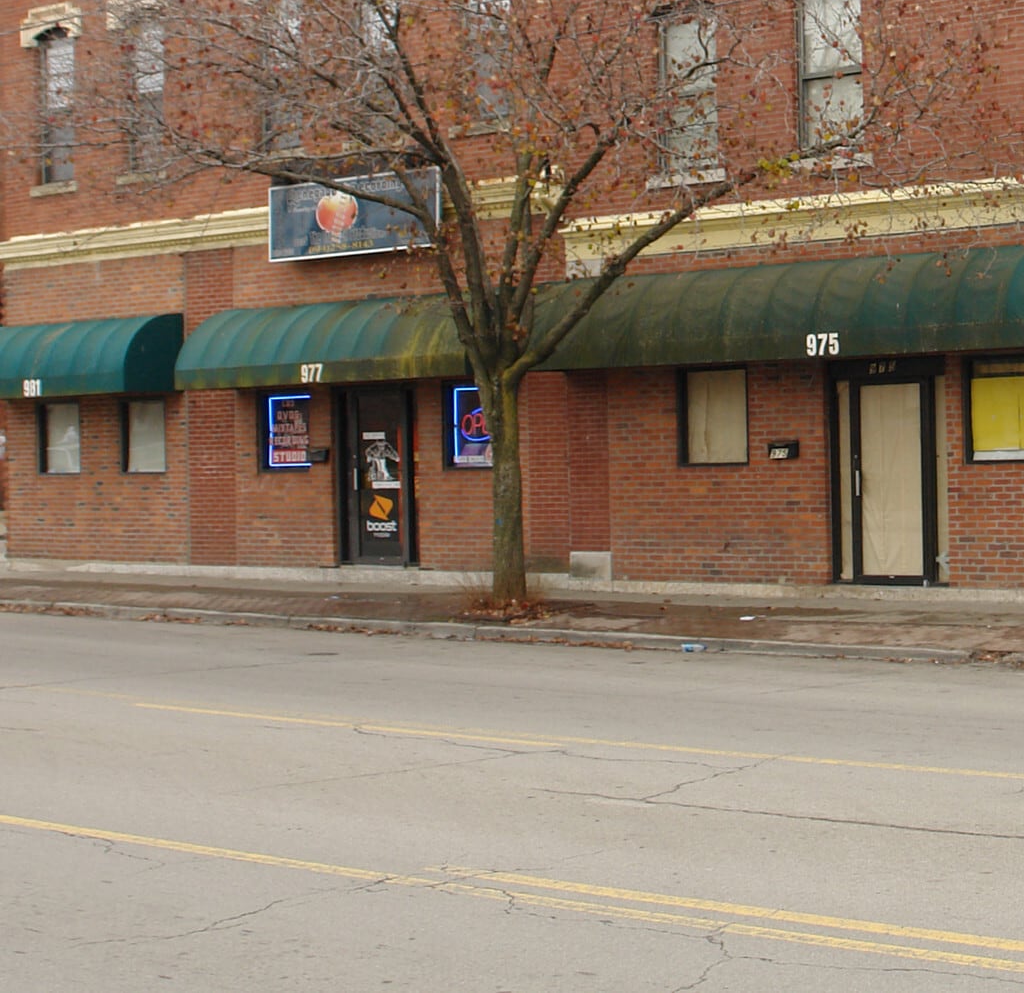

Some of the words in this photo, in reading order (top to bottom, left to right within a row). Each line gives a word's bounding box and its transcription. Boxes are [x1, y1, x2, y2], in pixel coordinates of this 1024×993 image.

[806, 333, 840, 356] 975
[301, 363, 323, 383] 977
[23, 379, 42, 397] 981
[273, 451, 307, 463] STUDIO
[366, 520, 398, 532] boost
